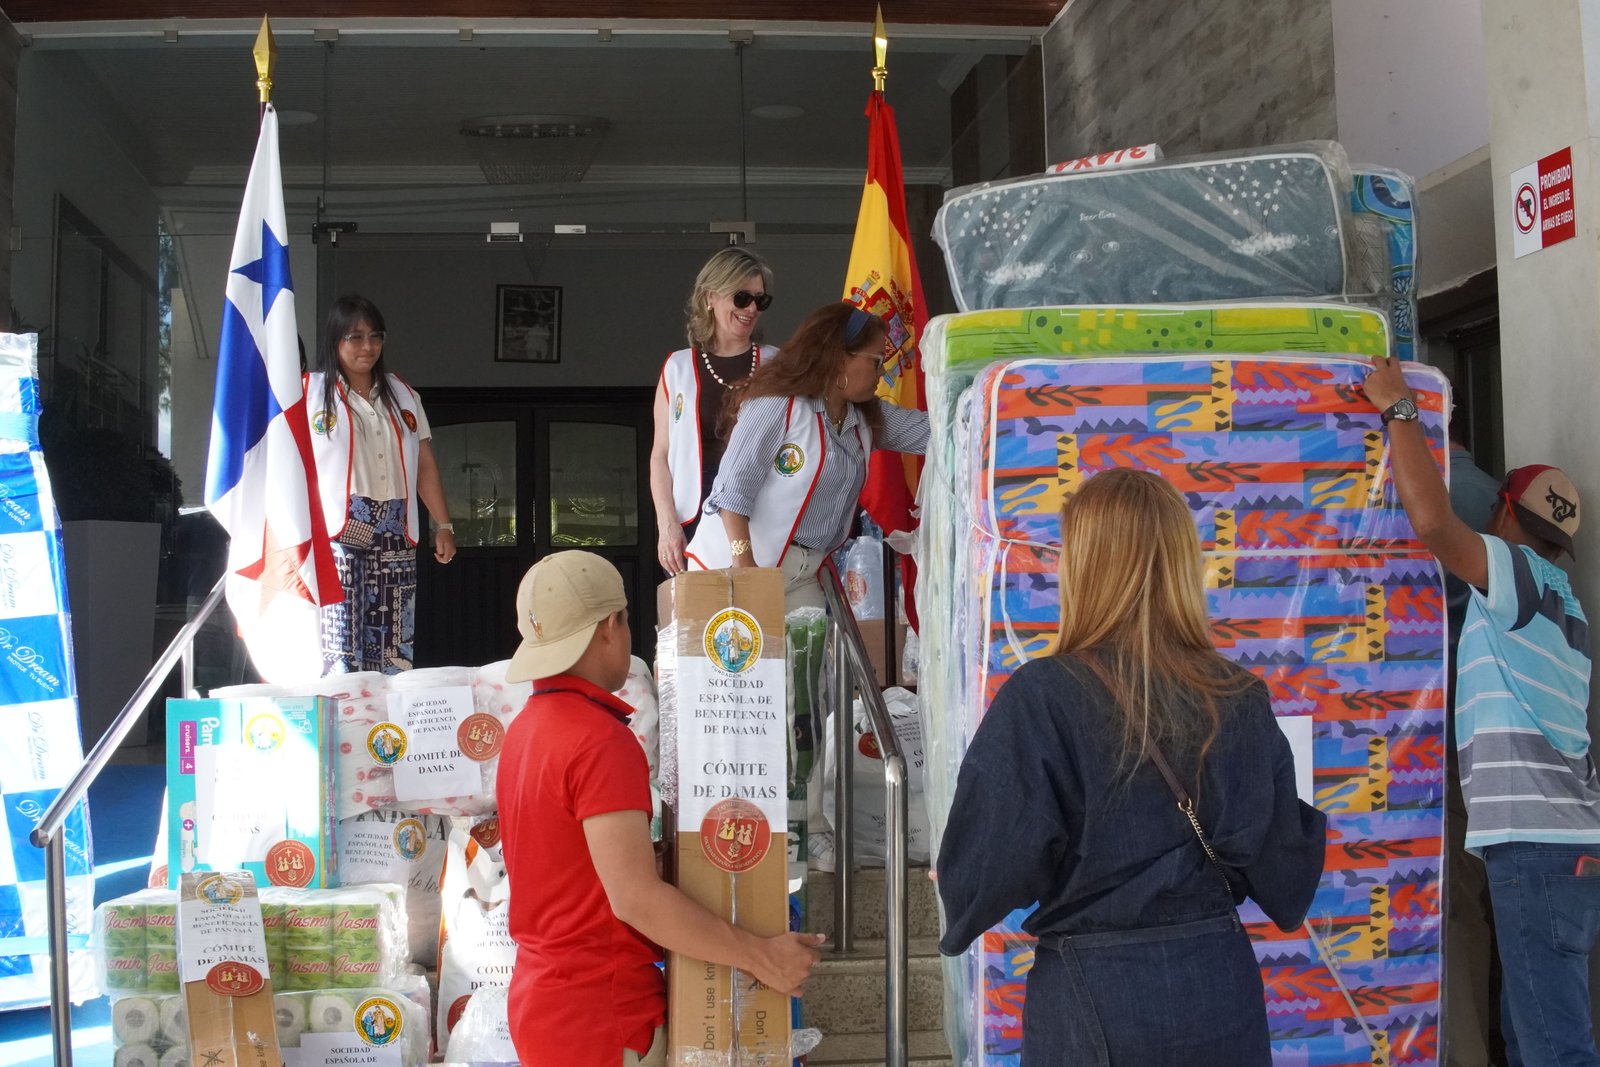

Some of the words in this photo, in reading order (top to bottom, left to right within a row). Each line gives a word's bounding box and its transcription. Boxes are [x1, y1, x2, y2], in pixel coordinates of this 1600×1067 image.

[1540, 164, 1571, 191] PROHIBIDO
[1543, 198, 1549, 210] EL
[1560, 208, 1573, 224] FUEGO
[6, 655, 28, 673] PROTEGE
[11, 645, 60, 687] Dream
[412, 699, 447, 708] SOCIEDAD
[758, 696, 773, 704] DE
[704, 725, 719, 734] DE
[184, 724, 192, 752] cruisers
[450, 750, 463, 758] DE
[418, 763, 455, 774] DAMAS
[703, 759, 768, 776] CÓMITE
[694, 785, 715, 798] DE
[721, 785, 777, 799] DAMAS
[354, 833, 389, 841] SOCIEDAD
[203, 943, 257, 954] CÓMITE
[489, 939, 517, 948] PANAM
[197, 957, 214, 966] DE
[218, 954, 266, 964] DAMAS
[706, 987, 716, 1009] use
[702, 1015, 716, 1050] Don't
[330, 1046, 371, 1055] SOCIEDAD
[325, 1056, 366, 1065] ESPAÑOLA
